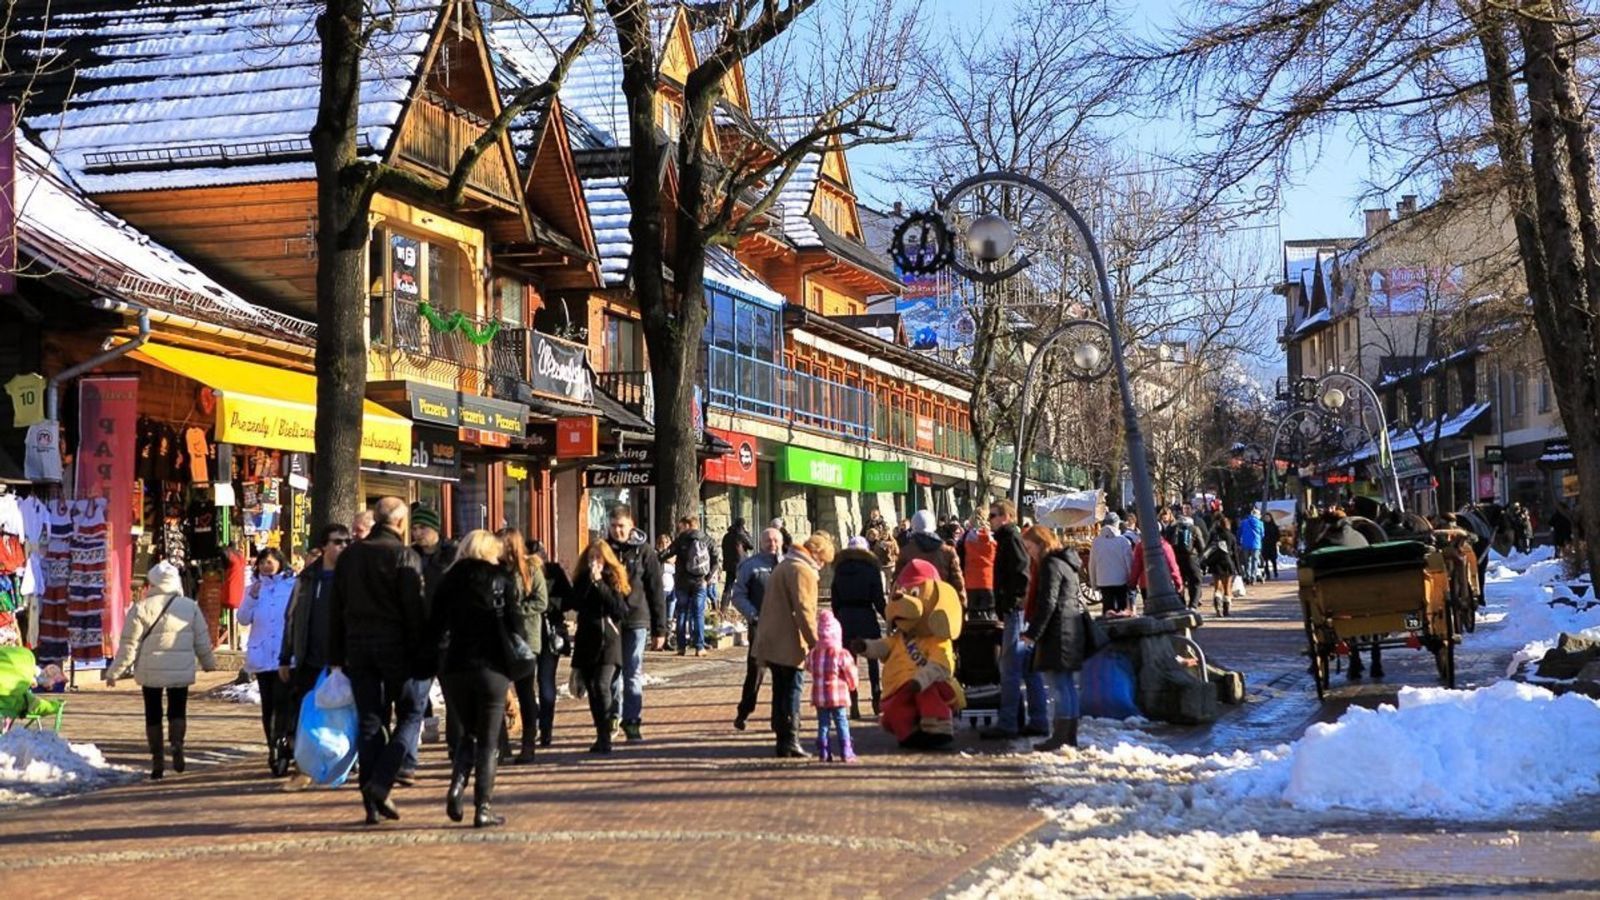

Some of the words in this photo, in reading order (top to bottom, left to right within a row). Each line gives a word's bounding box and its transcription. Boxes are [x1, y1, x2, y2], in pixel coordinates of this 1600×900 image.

[20, 391, 35, 406] 10
[418, 397, 449, 418] Pizzeria
[459, 405, 486, 425] Pizzeria
[495, 413, 521, 431] Pizzeria
[412, 440, 429, 468] ab
[608, 471, 649, 485] killtec
[809, 459, 844, 485] natura
[866, 471, 903, 481] natura
